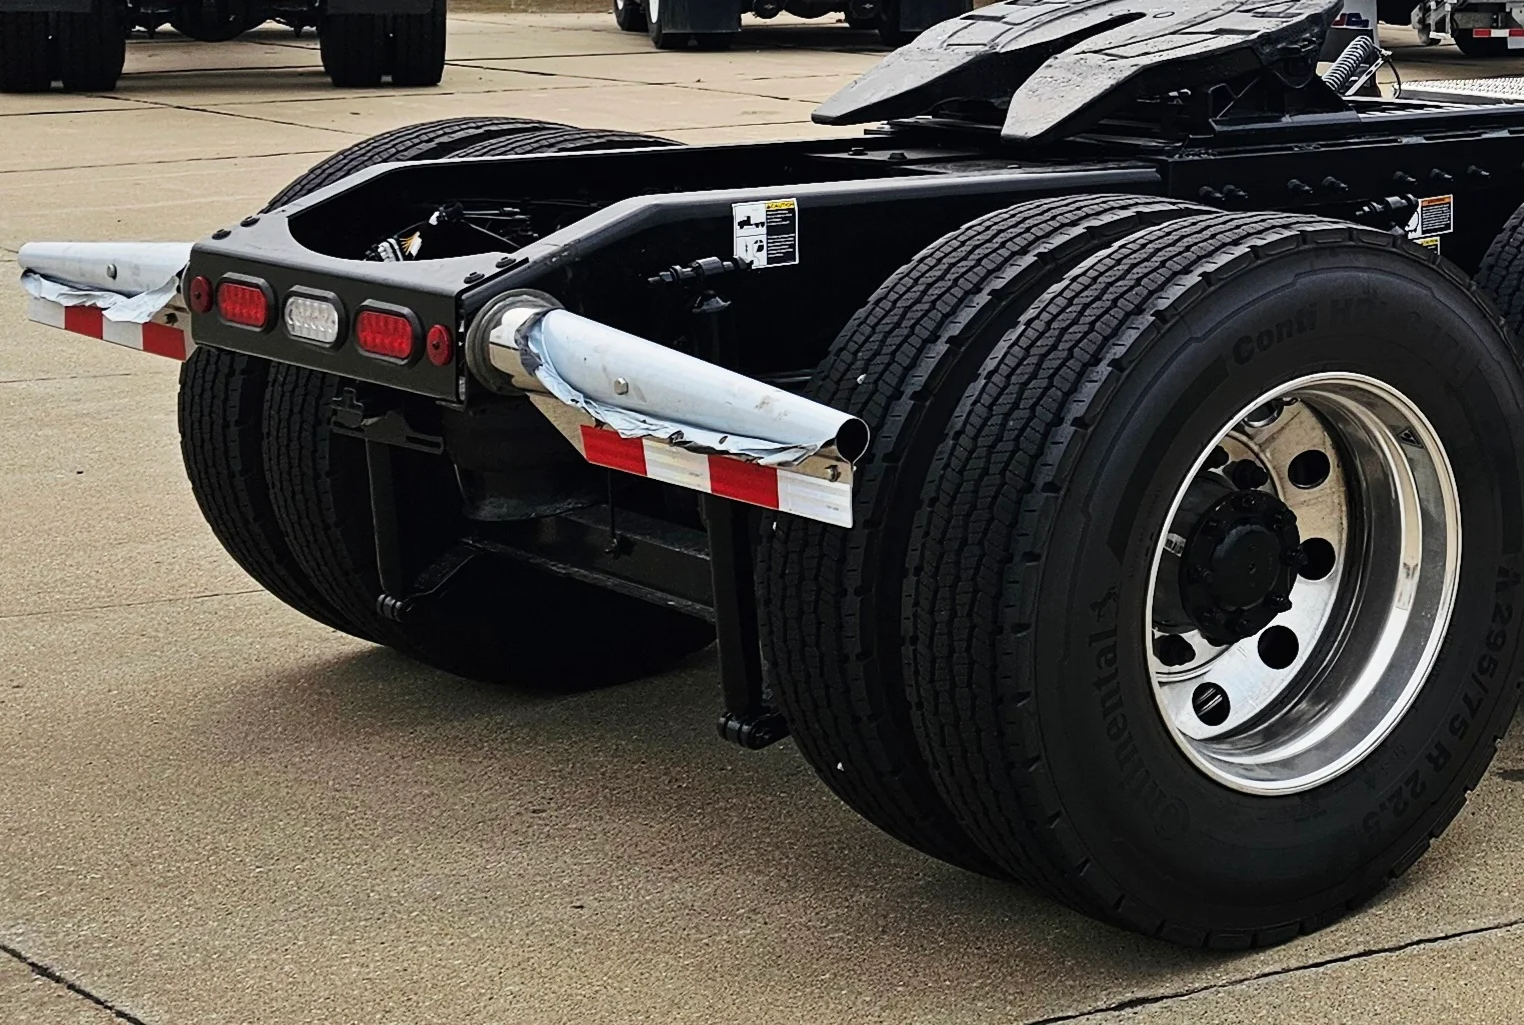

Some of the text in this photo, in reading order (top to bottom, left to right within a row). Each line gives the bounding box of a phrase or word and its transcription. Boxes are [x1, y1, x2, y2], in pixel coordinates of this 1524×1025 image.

[1232, 302, 1318, 366] Conti
[1448, 601, 1514, 741] 295/75
[1425, 740, 1452, 774] R
